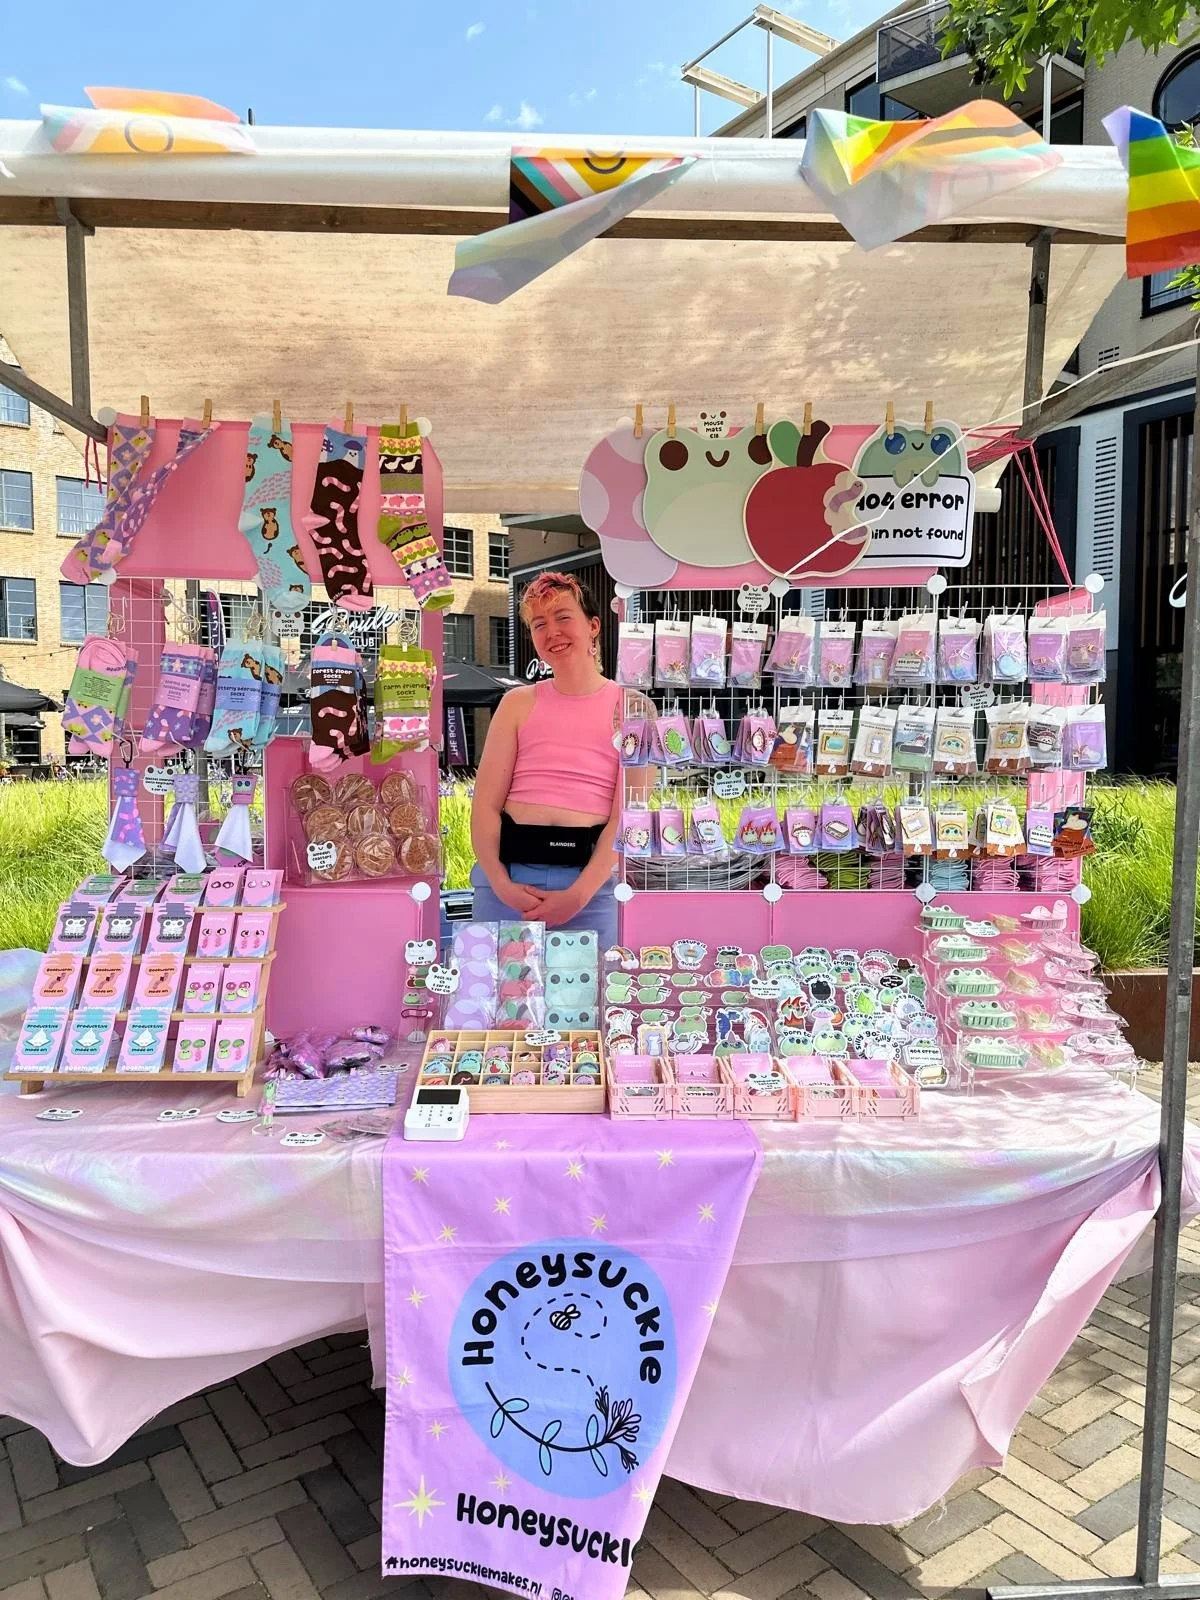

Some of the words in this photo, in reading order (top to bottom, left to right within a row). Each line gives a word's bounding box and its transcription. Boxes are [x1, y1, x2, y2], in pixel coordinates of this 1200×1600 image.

[901, 492, 964, 510] error
[893, 527, 922, 538] not
[926, 528, 963, 540] found
[462, 1252, 665, 1384] Honeysuckle
[456, 1492, 641, 1567] Honeysuckl
